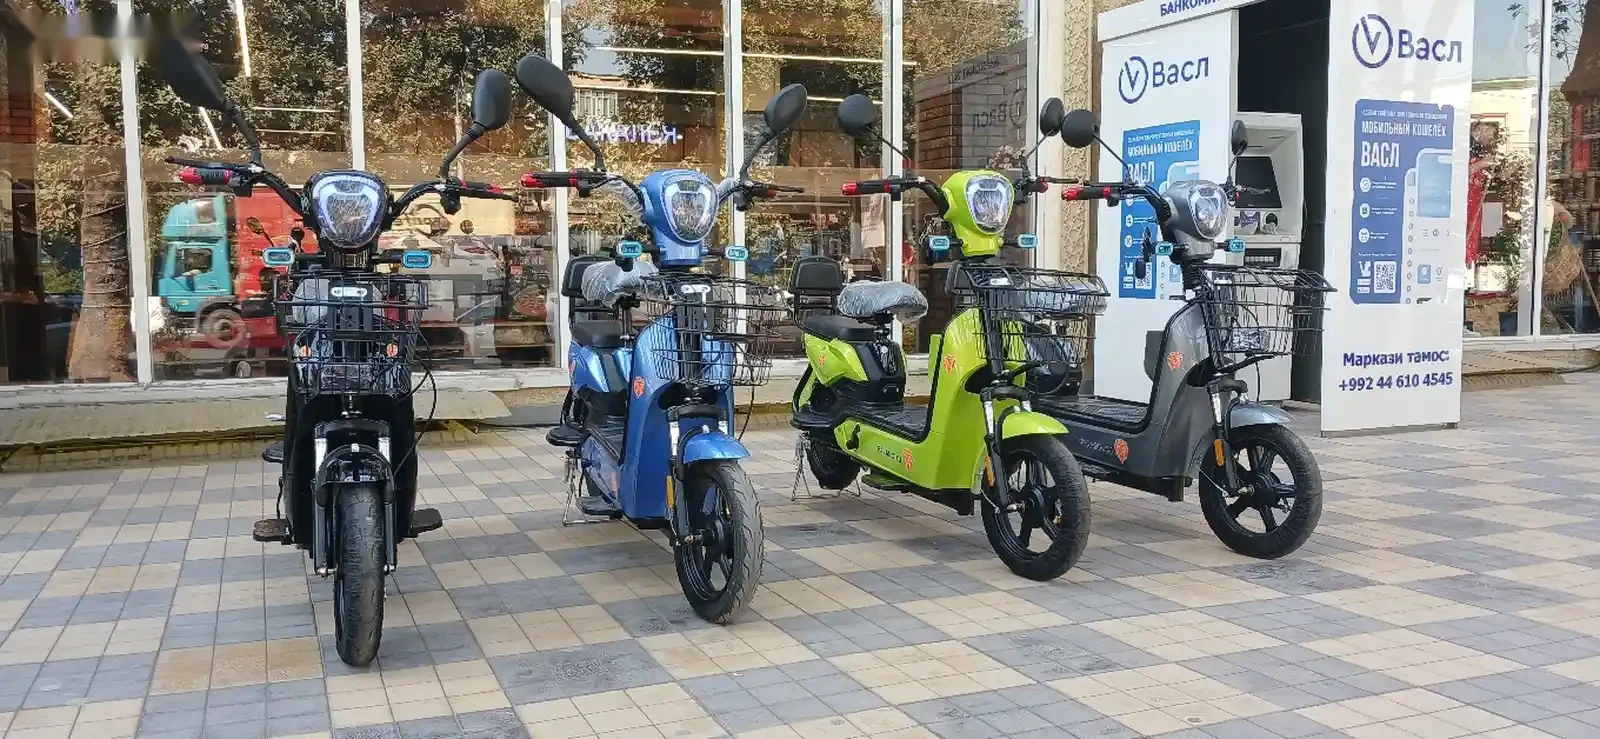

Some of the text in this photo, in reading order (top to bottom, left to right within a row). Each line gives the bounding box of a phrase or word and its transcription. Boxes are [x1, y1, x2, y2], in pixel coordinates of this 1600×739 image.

[1160, 0, 1220, 17] БАНКОМ
[1398, 29, 1462, 62] Васл
[1152, 57, 1209, 88] Васл
[1361, 121, 1447, 137] МОБИЛЬНЫЙ КОШЕЛЁК
[1361, 141, 1400, 168] ВАСЛ
[1126, 161, 1155, 183] ВАСЛ
[1343, 351, 1450, 369] Маркази тамос:
[1339, 372, 1454, 392] +992 44 610 4545
